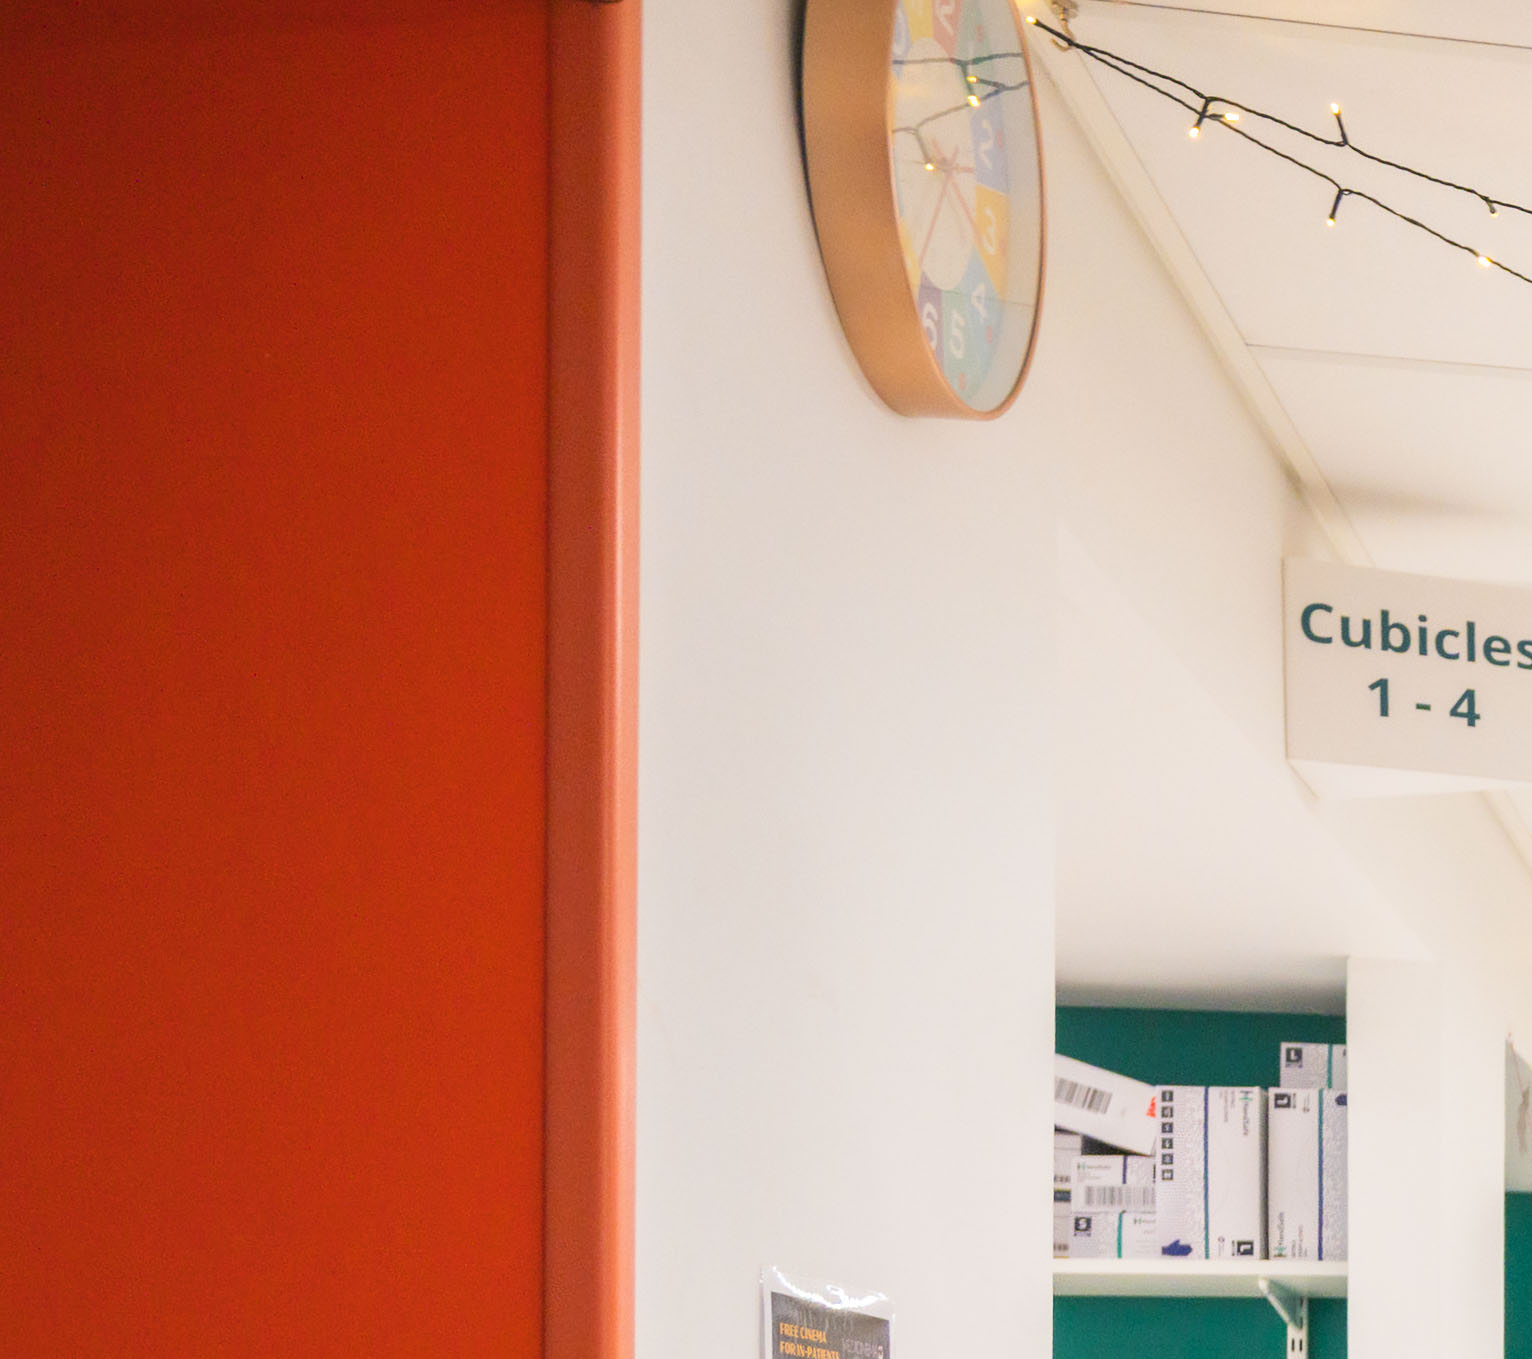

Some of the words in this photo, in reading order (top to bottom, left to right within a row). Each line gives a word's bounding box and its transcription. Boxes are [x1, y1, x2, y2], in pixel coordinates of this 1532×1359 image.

[1368, 677, 1390, 717] 1
[1415, 702, 1432, 712] -
[1449, 688, 1481, 727] 4
[779, 1321, 799, 1339] FREE
[779, 1340, 795, 1356] FOR
